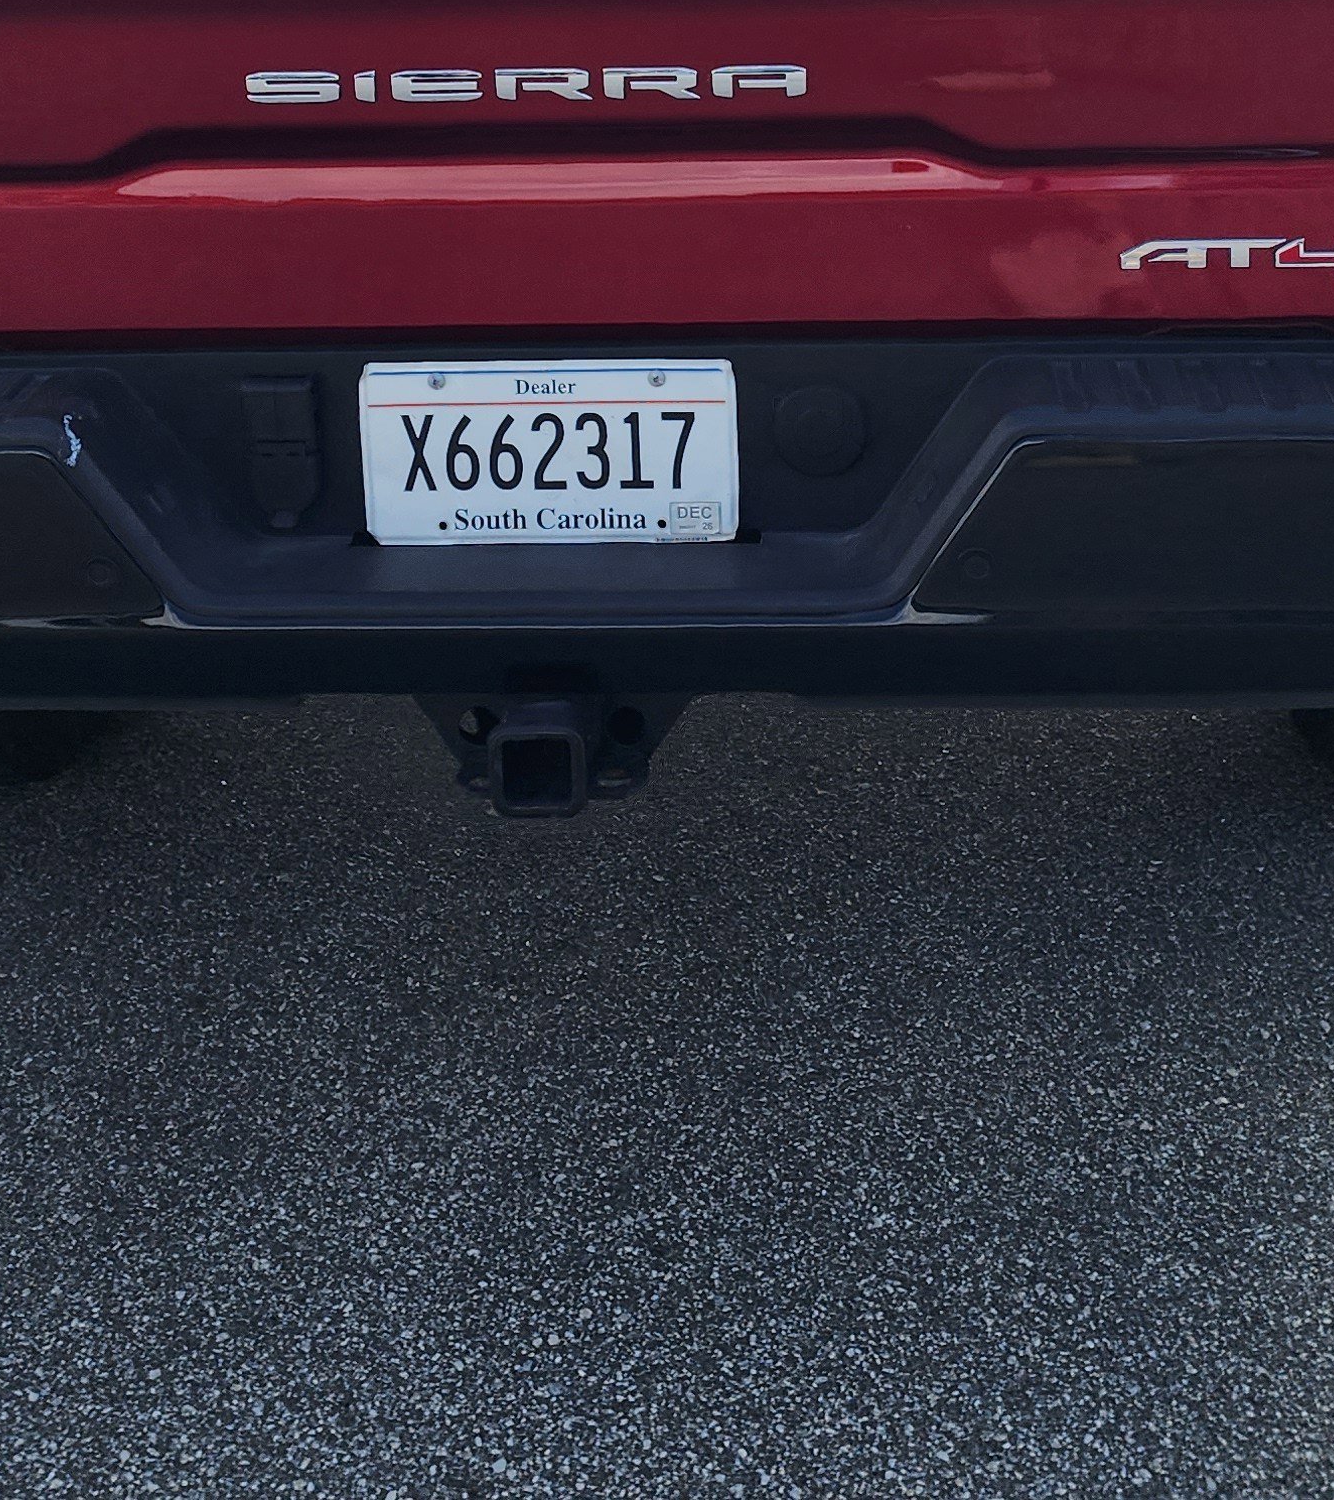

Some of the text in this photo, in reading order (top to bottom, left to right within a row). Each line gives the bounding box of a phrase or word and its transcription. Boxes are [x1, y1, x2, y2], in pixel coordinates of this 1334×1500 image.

[244, 64, 808, 105] SIERRA
[514, 378, 577, 396] Dealer
[400, 411, 696, 493] X662317
[453, 507, 647, 531] South Carolina
[677, 506, 713, 520] DEC
